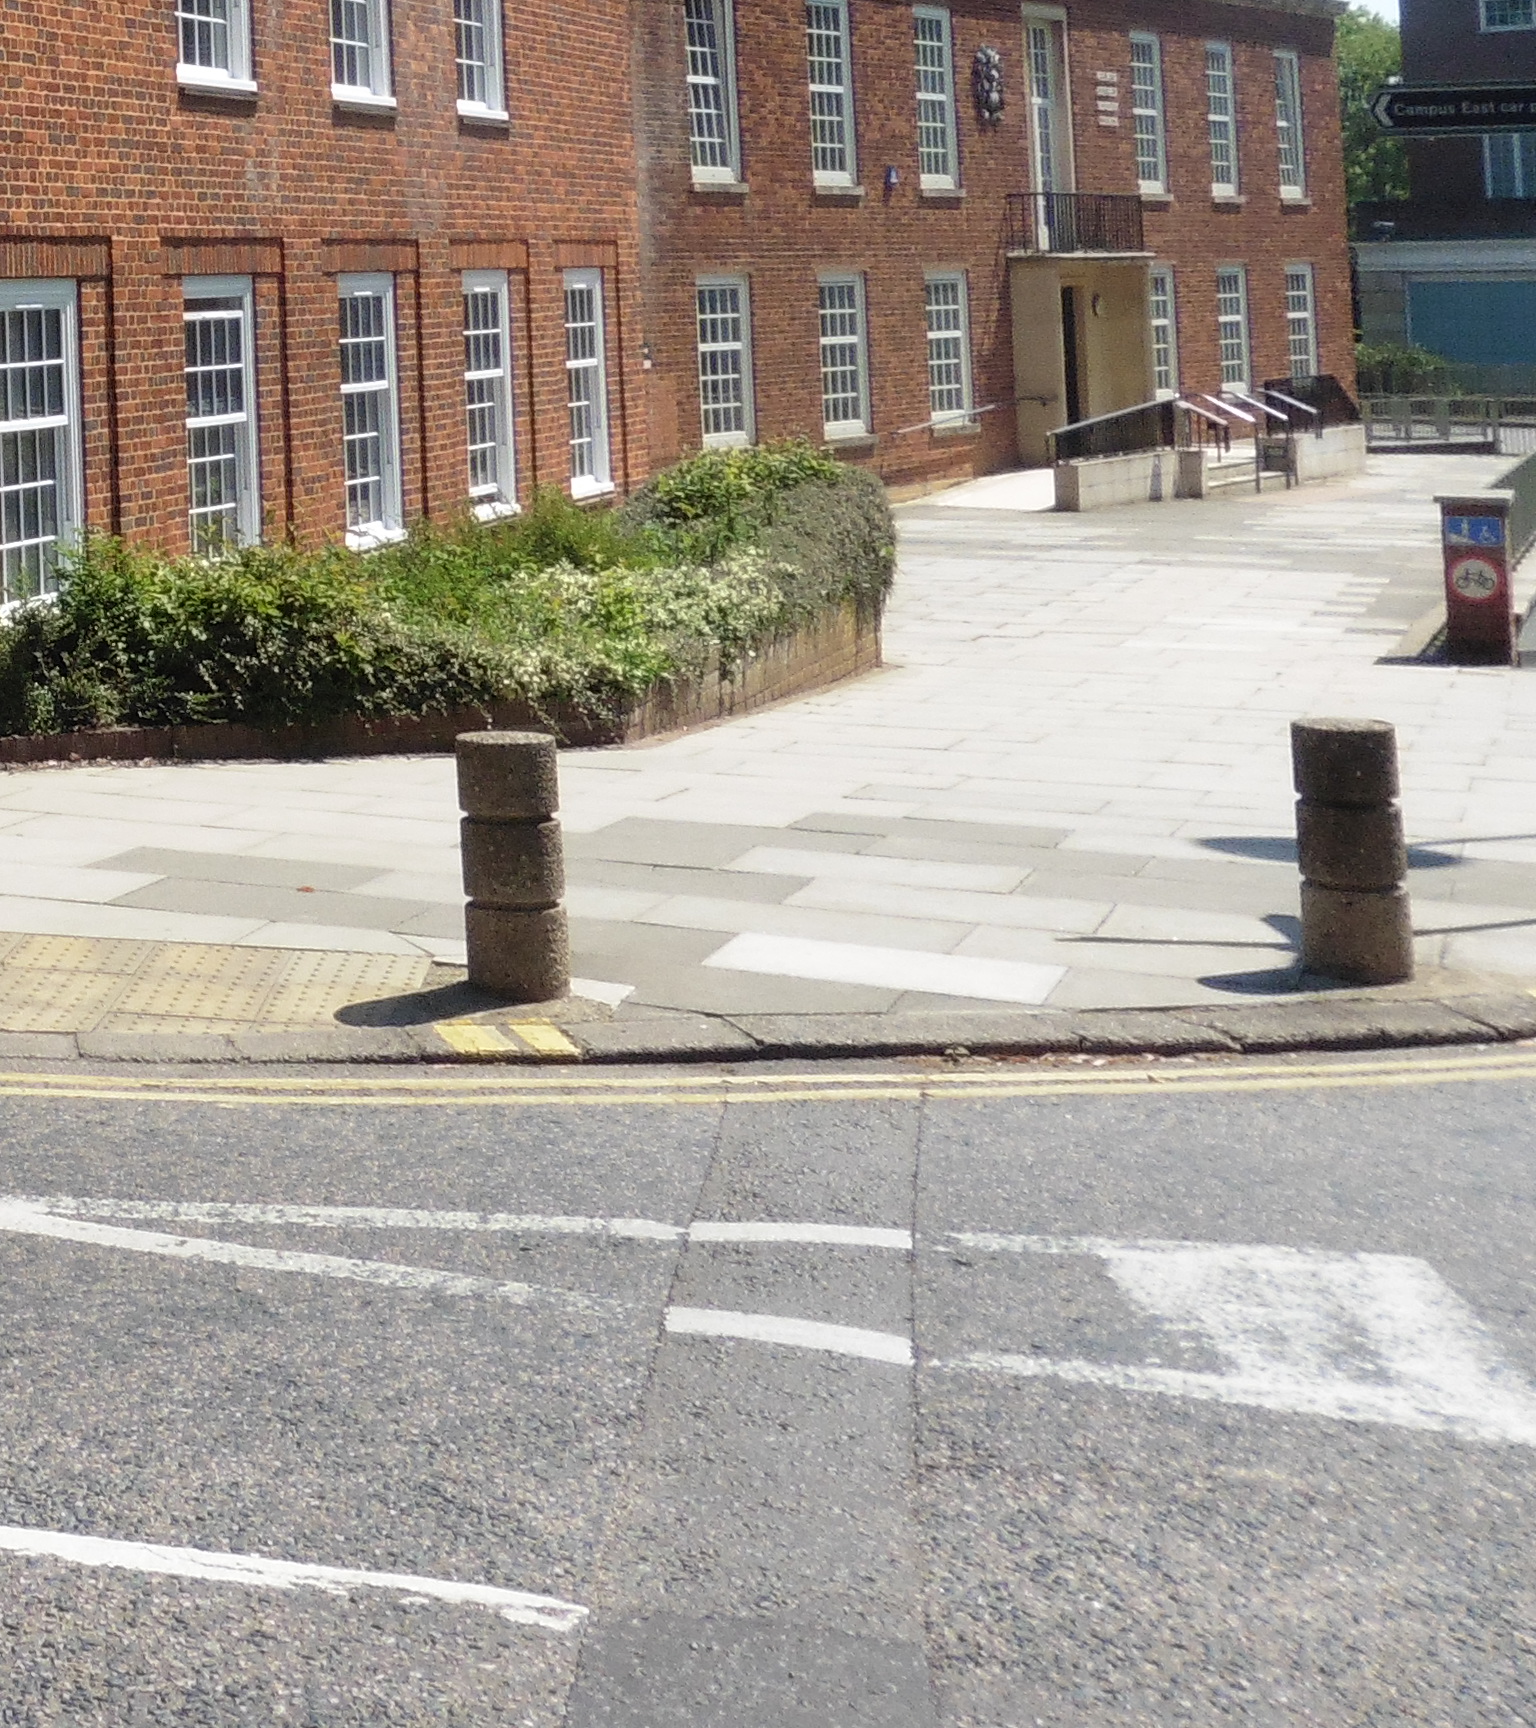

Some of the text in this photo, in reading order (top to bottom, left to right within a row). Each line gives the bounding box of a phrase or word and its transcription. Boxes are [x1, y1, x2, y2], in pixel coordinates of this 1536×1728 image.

[1394, 103, 1456, 116] Campus
[1461, 101, 1495, 114] East
[1500, 102, 1524, 113] car
